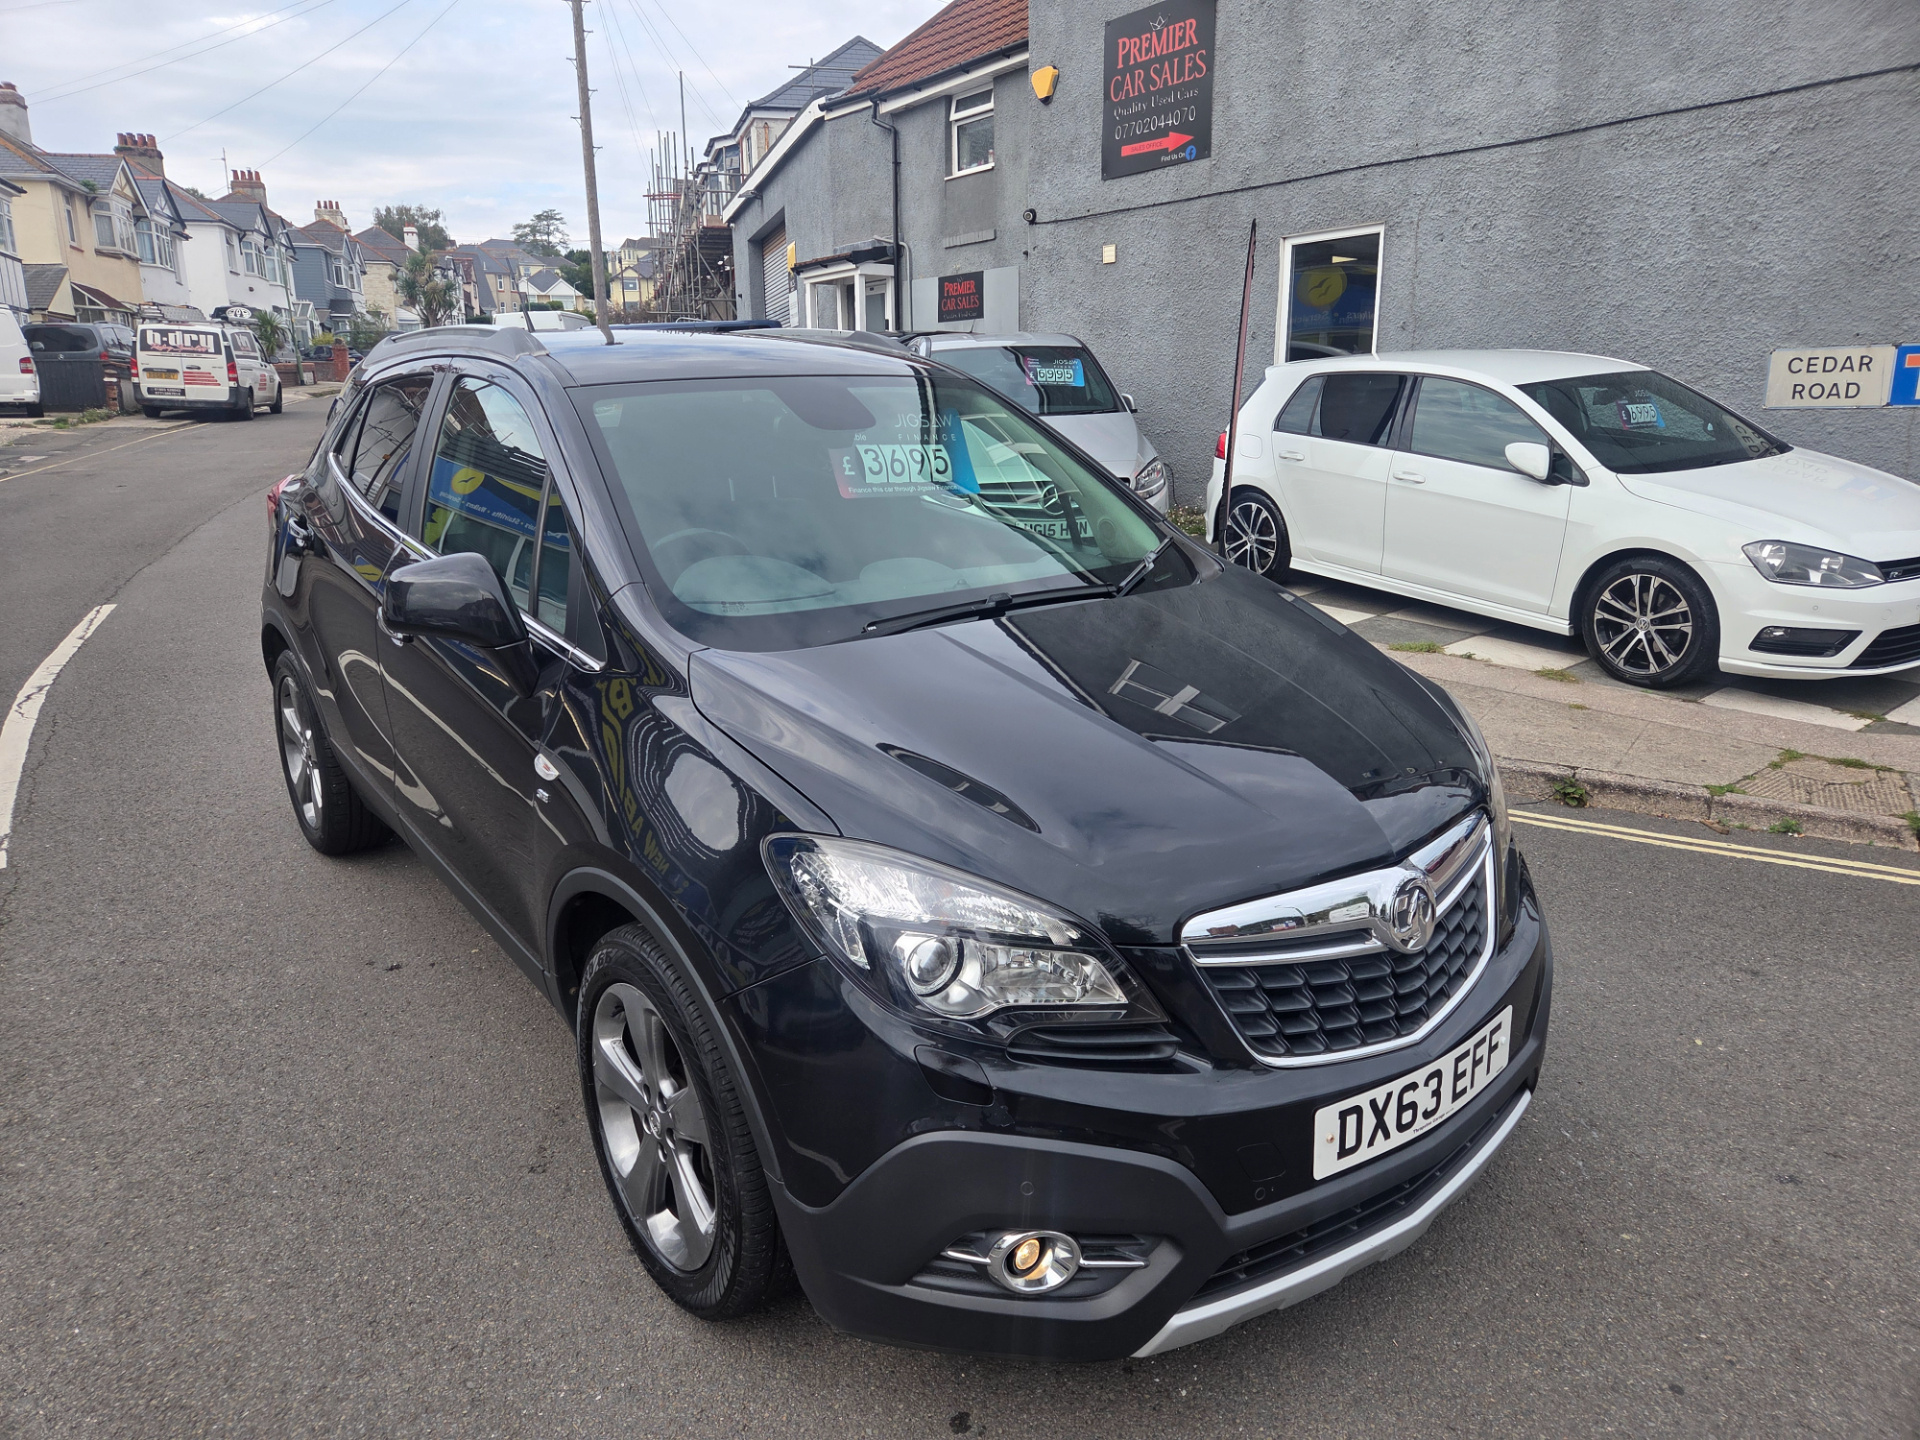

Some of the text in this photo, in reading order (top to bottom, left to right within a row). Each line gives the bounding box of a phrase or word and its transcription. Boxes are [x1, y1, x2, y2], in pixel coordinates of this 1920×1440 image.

[1117, 18, 1198, 69] PREMIER
[1110, 50, 1207, 102] CAR SALES
[1113, 87, 1199, 120] Quality Used Cars
[1115, 105, 1196, 140] 07702044070
[1131, 141, 1163, 152] SALES OFFICE
[944, 280, 976, 296] PREMIER
[941, 295, 980, 311] CAR SALES
[1787, 355, 1873, 374] CEDAR
[1038, 369, 1073, 380] 6995
[1791, 382, 1861, 400] ROAD
[894, 413, 953, 428] JIGSAW
[1630, 405, 1656, 420] 6995
[898, 433, 957, 441] FINANCE
[842, 448, 949, 477] £ 3695
[848, 486, 872, 494] Finance
[894, 485, 917, 493] through
[1060, 521, 1087, 536] HN
[1337, 1020, 1503, 1161] DX63 EFF
